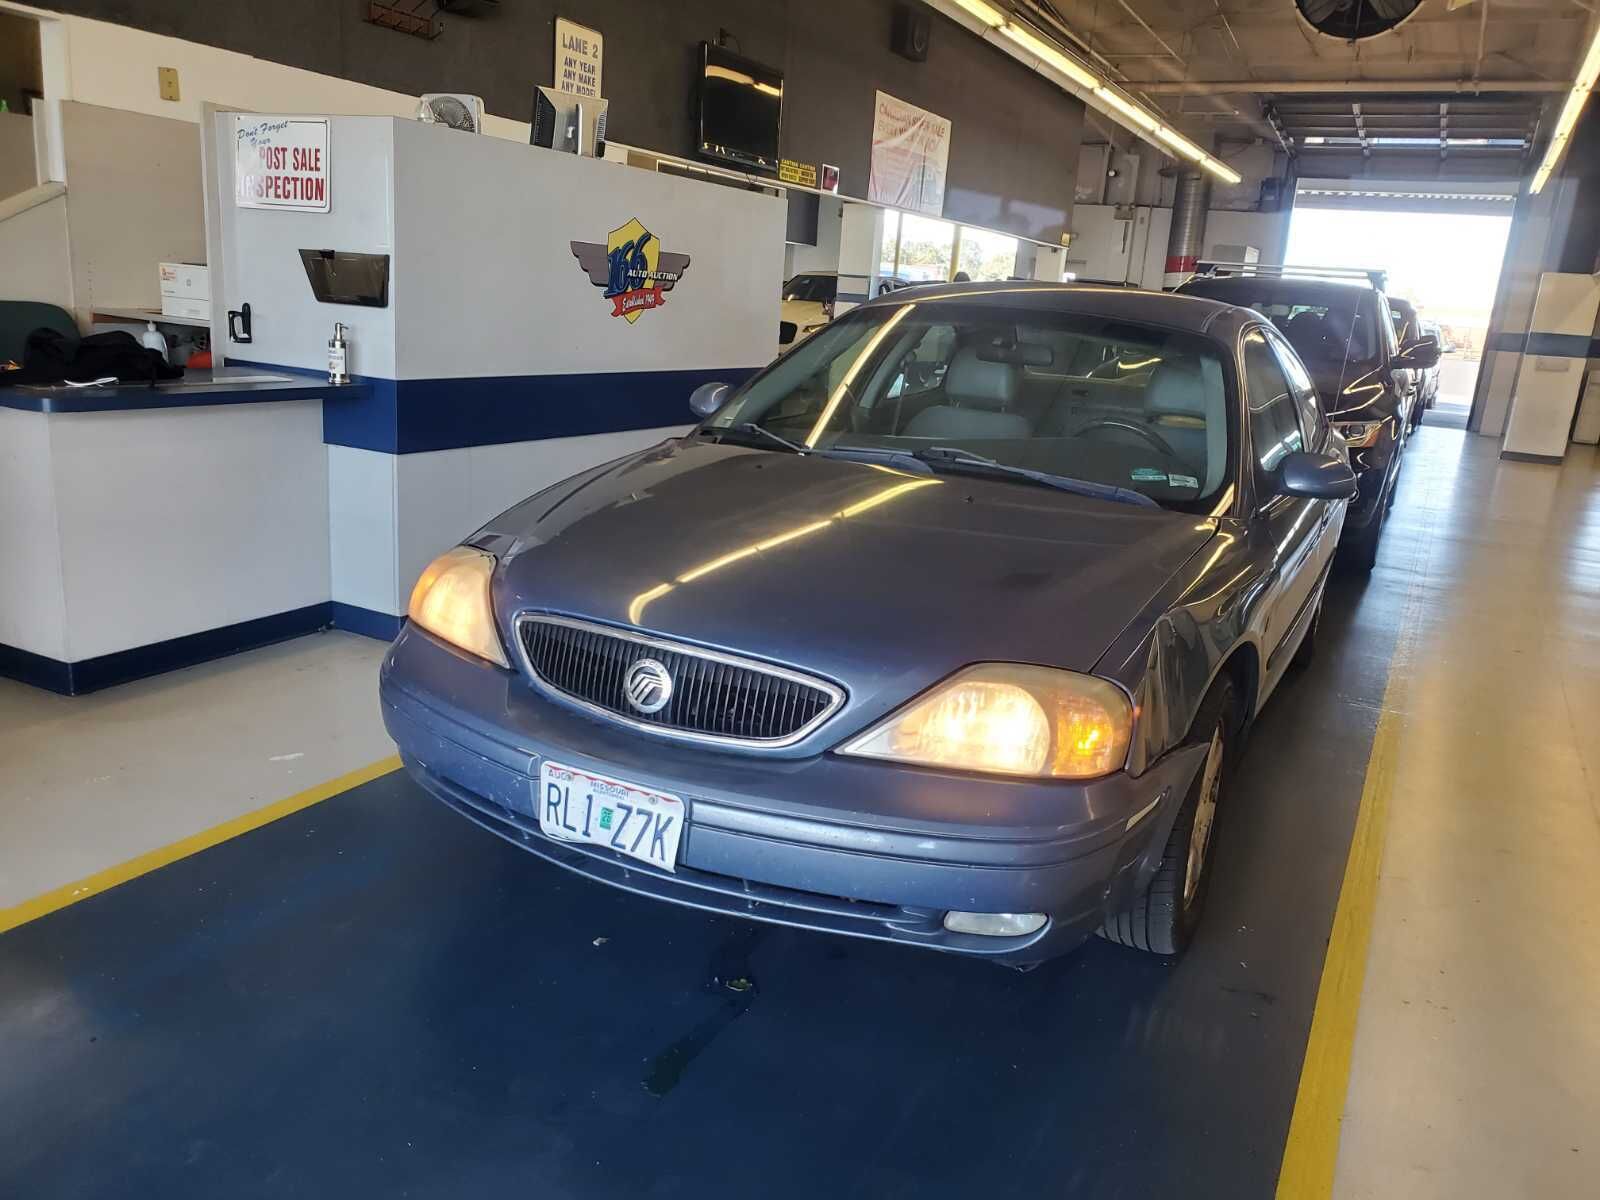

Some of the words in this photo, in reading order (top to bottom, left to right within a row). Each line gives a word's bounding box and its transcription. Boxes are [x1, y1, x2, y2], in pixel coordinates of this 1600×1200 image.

[562, 32, 588, 55] LANE
[592, 43, 599, 59] 2
[563, 56, 577, 69] ANY
[579, 60, 596, 76] YEAR
[561, 80, 575, 93] ANY
[563, 69, 577, 81] ANY
[578, 73, 596, 87] MAKE
[260, 120, 289, 134] Forget
[292, 147, 321, 172] SALE
[603, 232, 652, 299] 166
[627, 269, 648, 279] AUTO
[648, 271, 679, 282] AUCTION
[590, 780, 629, 798] MISSOURI
